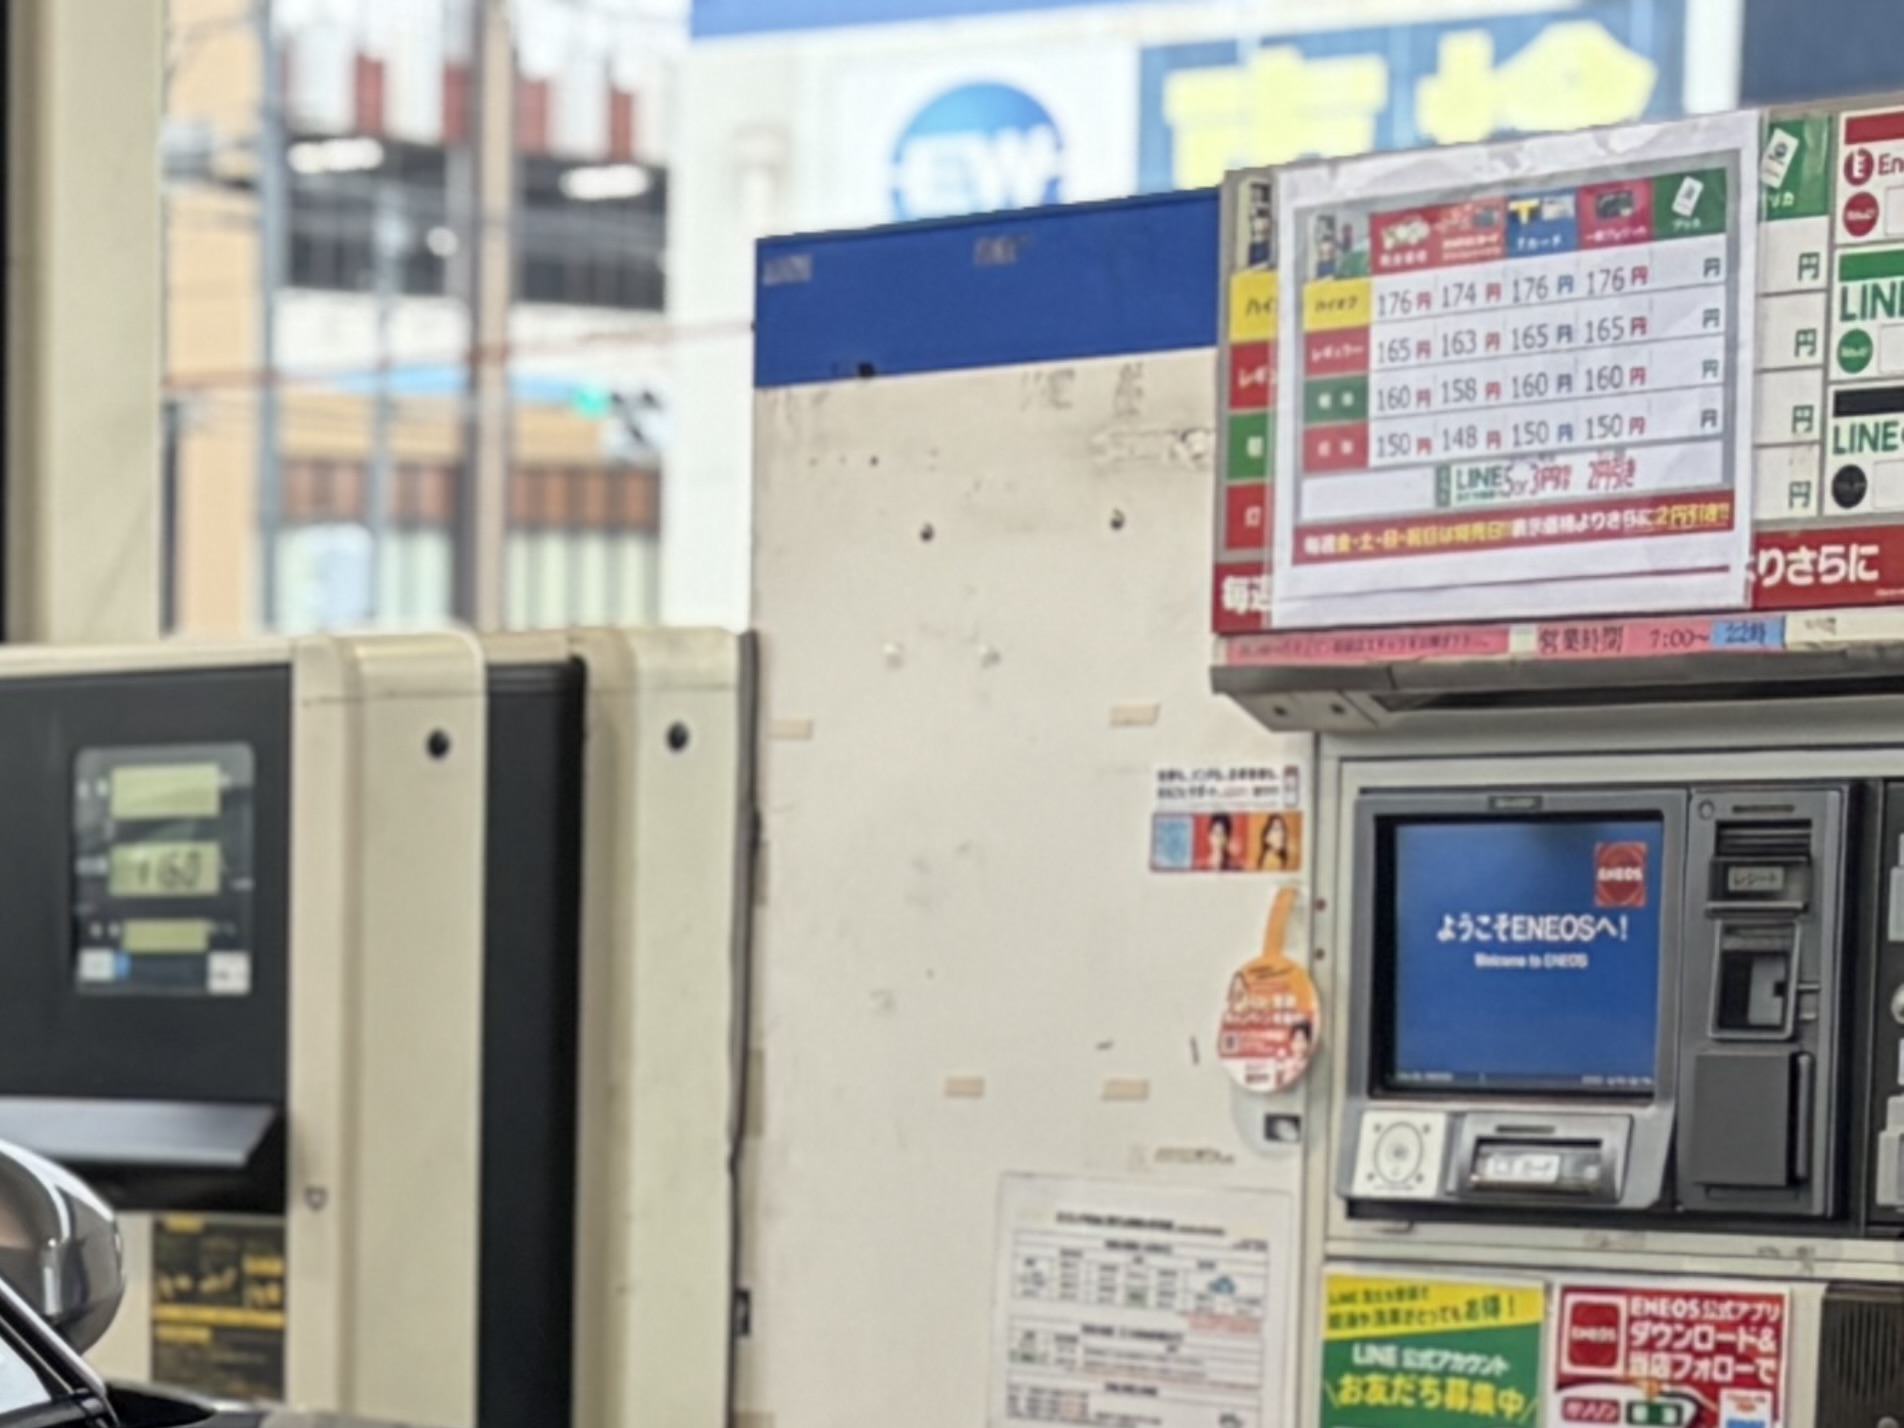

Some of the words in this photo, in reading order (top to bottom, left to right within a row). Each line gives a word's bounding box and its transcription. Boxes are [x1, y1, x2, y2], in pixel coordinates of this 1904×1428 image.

[1798, 251, 1820, 282] 円
[1378, 290, 1412, 318] 176
[1441, 282, 1477, 309] 174
[1513, 274, 1549, 303] 176
[1586, 267, 1626, 296] 176
[1377, 338, 1411, 365] 165
[1441, 329, 1477, 358] 163
[1512, 323, 1549, 352] 165
[1586, 316, 1625, 344] 165
[1794, 328, 1817, 358] 円
[1377, 385, 1411, 413] 160
[1441, 377, 1478, 404] 158
[1512, 372, 1549, 399] 160
[1586, 365, 1623, 392] 160
[1792, 404, 1814, 434] 円
[1377, 432, 1412, 459] 150
[1441, 425, 1478, 451] 148
[1512, 420, 1550, 448] 150
[1586, 413, 1623, 441] 150
[1833, 420, 1904, 456] LINE
[1788, 480, 1812, 510] 円
[1538, 625, 1624, 654] 営業時間
[1436, 912, 1629, 943] ようこそENEOSへ!
[1473, 952, 1526, 969] Welcome
[1630, 1319, 1777, 1354] ダウンロード&
[1352, 1342, 1398, 1368] LINE
[1337, 1371, 1526, 1420] お友だち募集中
